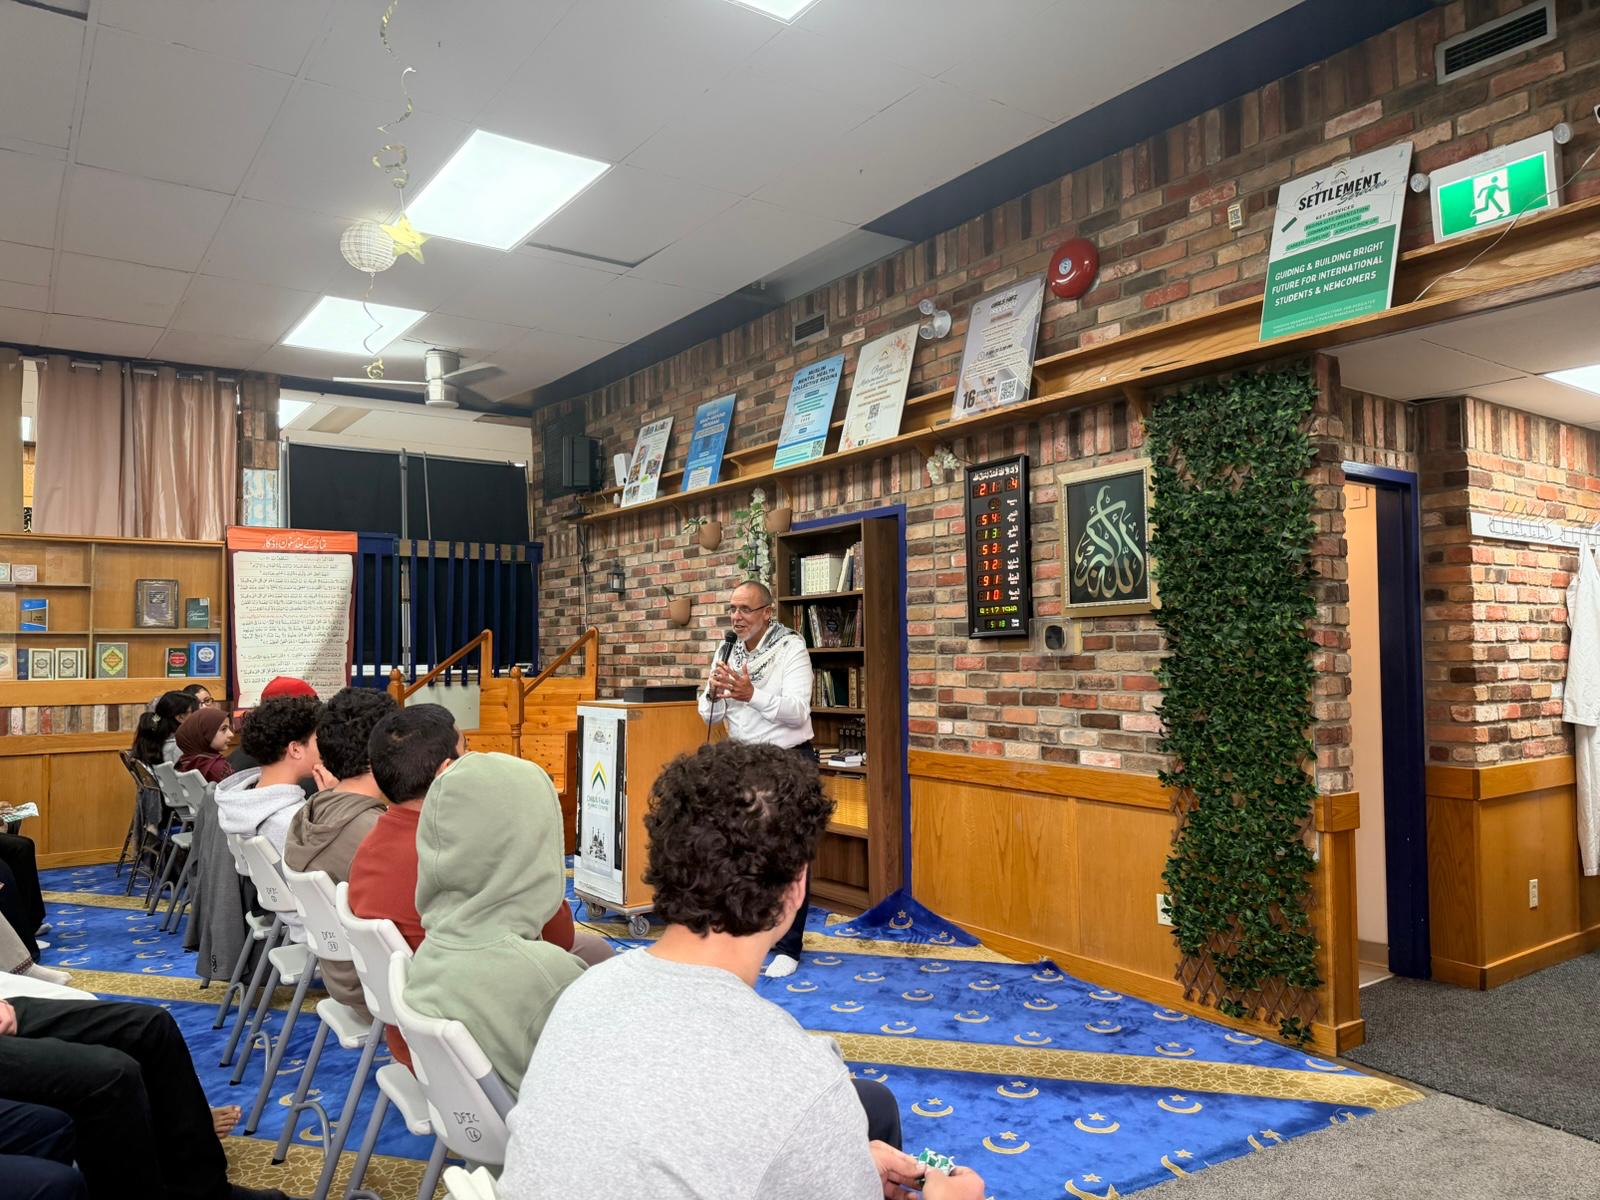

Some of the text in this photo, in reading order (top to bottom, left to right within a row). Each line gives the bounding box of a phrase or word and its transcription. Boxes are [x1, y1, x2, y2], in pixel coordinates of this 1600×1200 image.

[1299, 172, 1382, 211] SETTLEMENT
[1327, 204, 1355, 217] SERVICES
[1272, 255, 1384, 295] FUTURE FOR INTERNATIONAL
[1275, 241, 1384, 281] GUIDING & BUILDING BRIGHT
[1275, 270, 1377, 307] STUDENTS & NEWCOMERS
[963, 389, 977, 410] 16
[453, 1111, 480, 1125] DFIC
